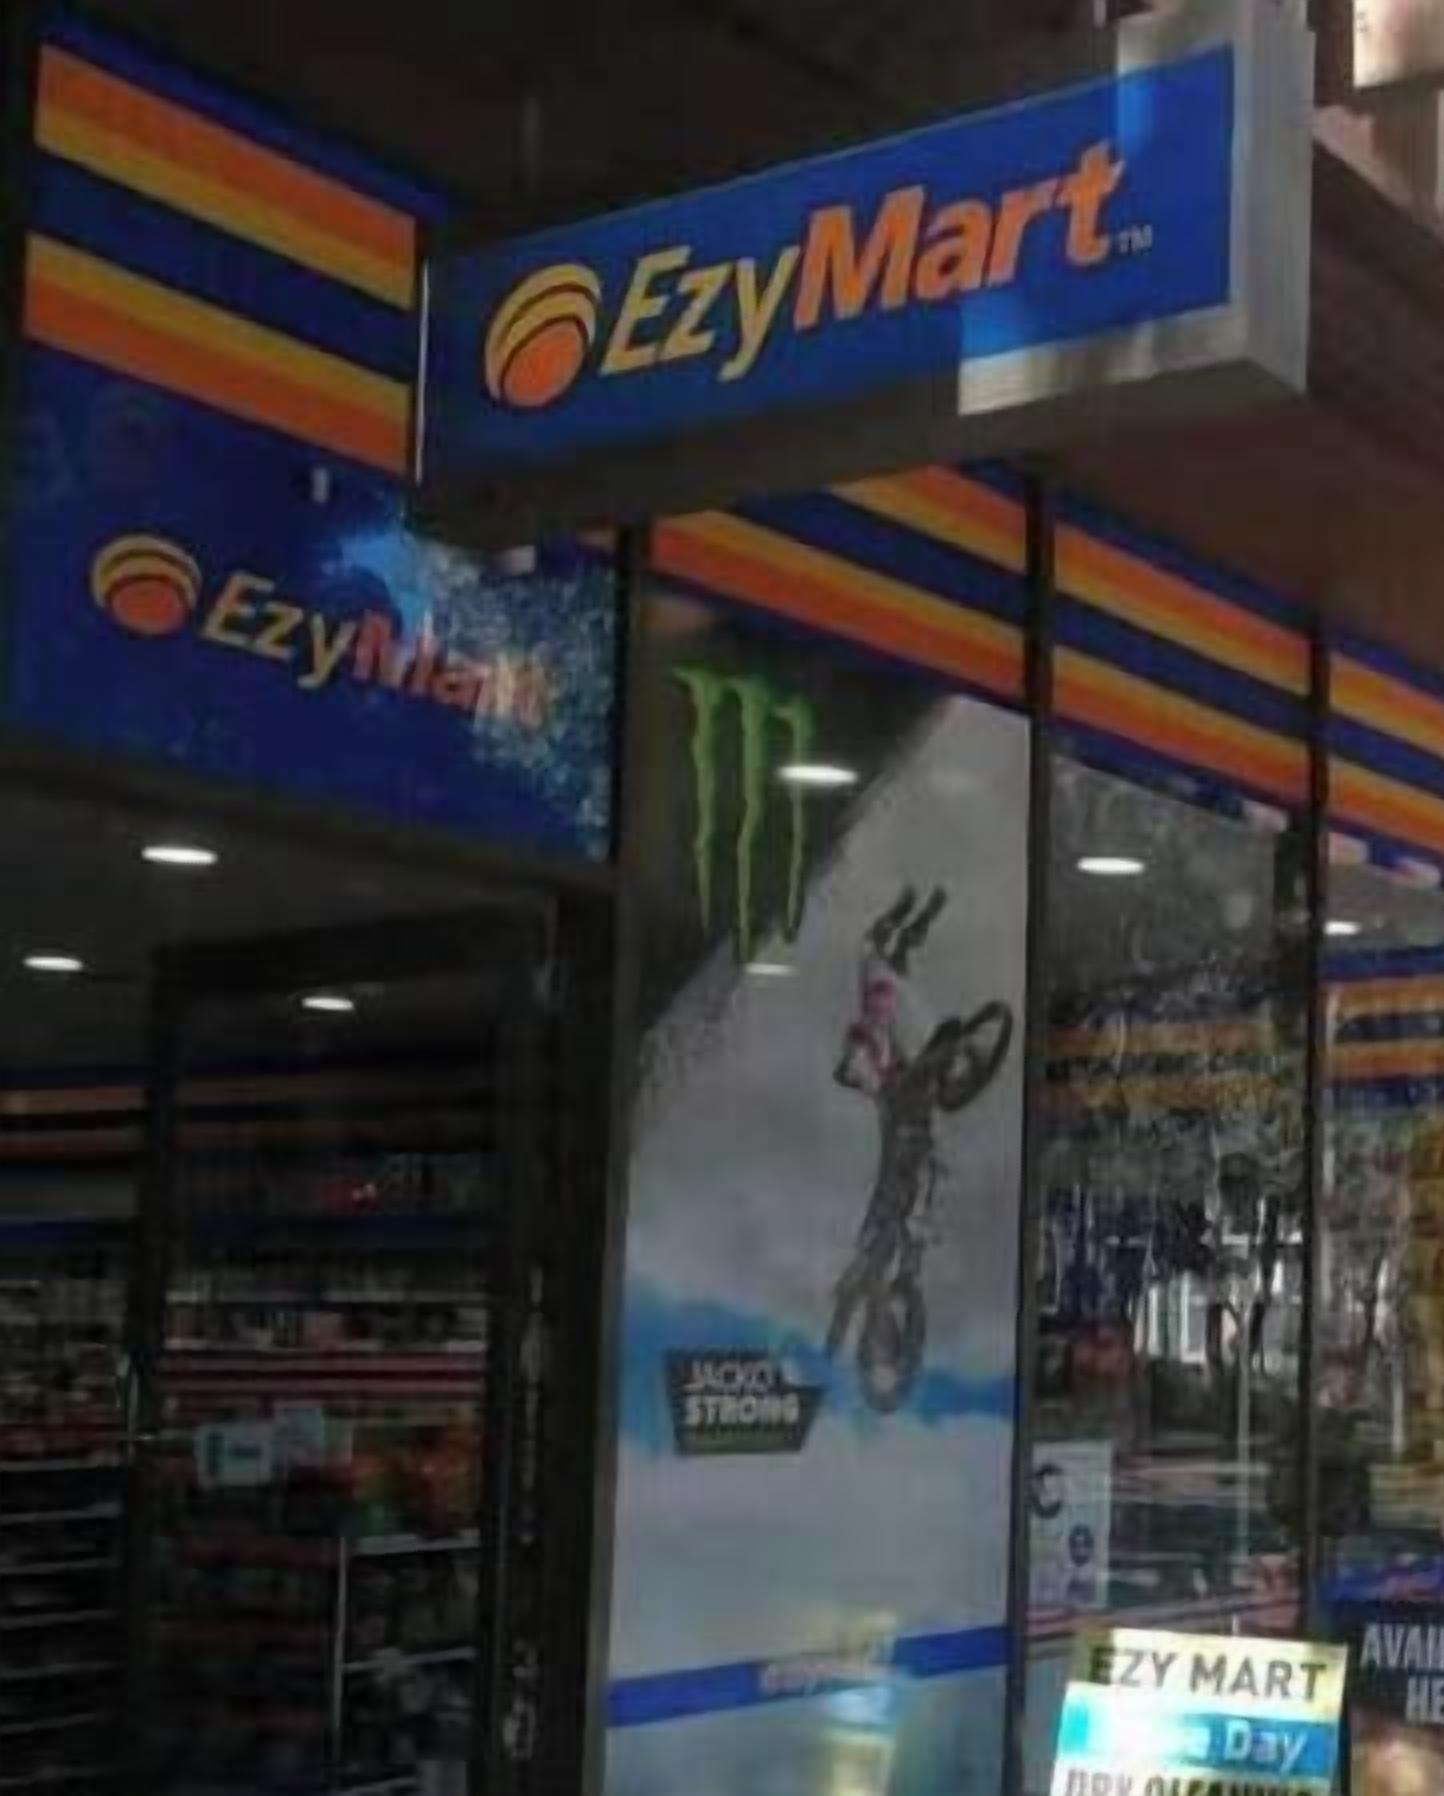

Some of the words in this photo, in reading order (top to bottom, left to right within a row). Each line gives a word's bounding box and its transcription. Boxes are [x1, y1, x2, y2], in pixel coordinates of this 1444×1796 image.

[601, 142, 1125, 382] EzyMart
[1090, 1647, 1177, 1688] EZY
[1189, 1654, 1327, 1701] MART
[1224, 1719, 1310, 1774] Day
